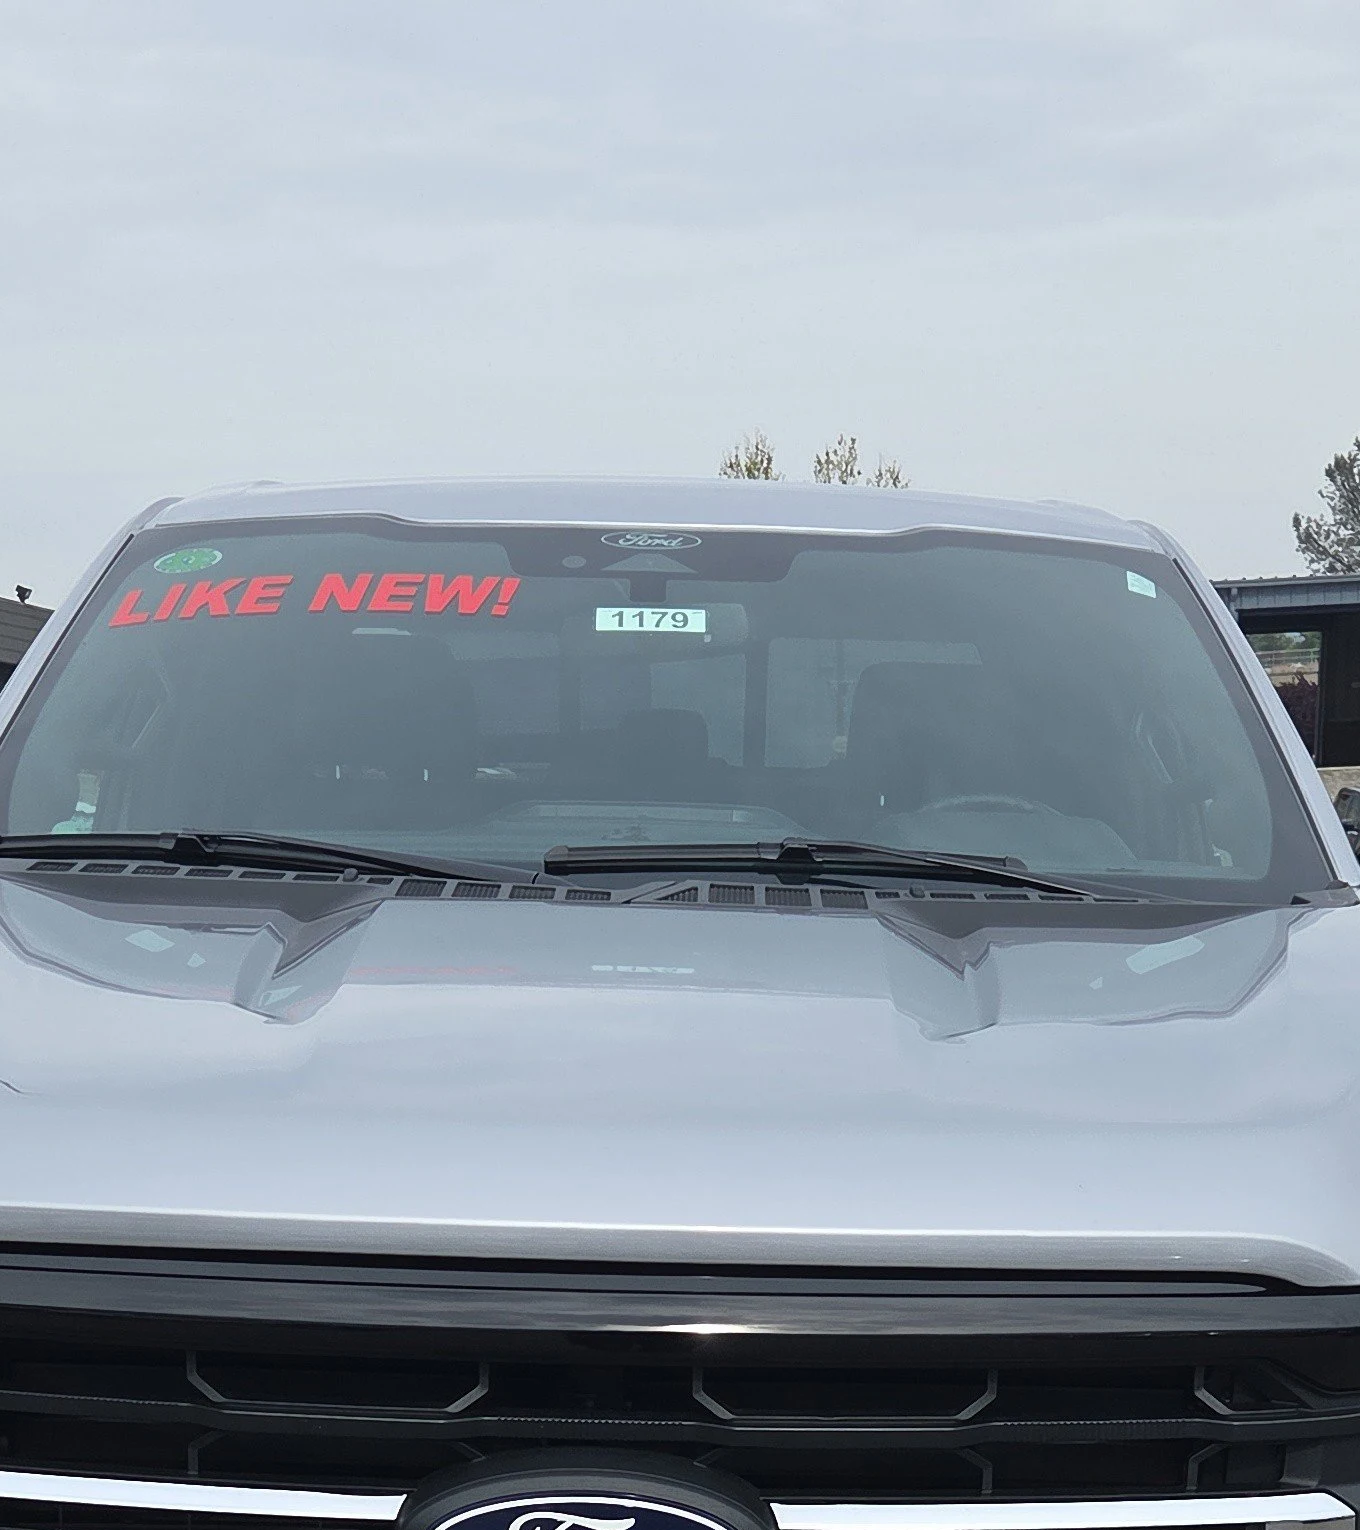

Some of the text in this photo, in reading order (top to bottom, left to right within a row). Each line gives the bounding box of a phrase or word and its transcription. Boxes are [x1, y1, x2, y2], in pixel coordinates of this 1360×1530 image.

[618, 533, 684, 546] Ford
[107, 572, 521, 630] LIKE NEW!
[611, 610, 689, 629] 1179
